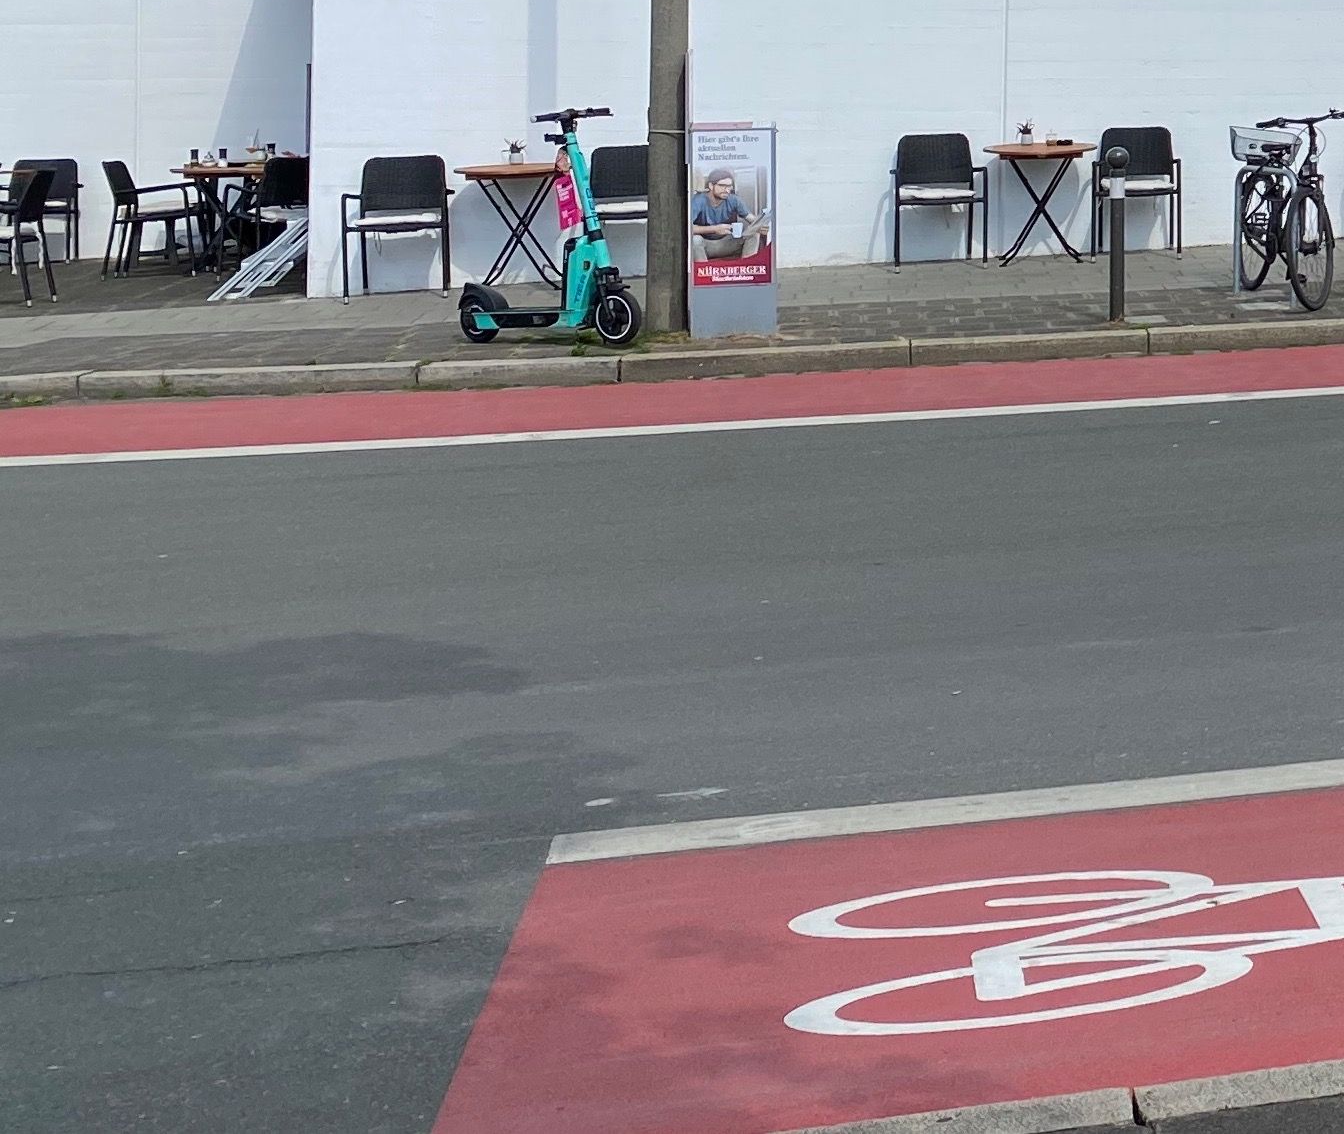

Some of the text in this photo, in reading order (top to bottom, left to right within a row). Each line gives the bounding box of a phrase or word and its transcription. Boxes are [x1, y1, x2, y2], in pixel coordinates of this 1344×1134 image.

[698, 135, 716, 143] Hier
[718, 135, 740, 144] gibt's
[698, 144, 736, 152] aktuellen
[697, 265, 767, 277] NÜRNBERGER
